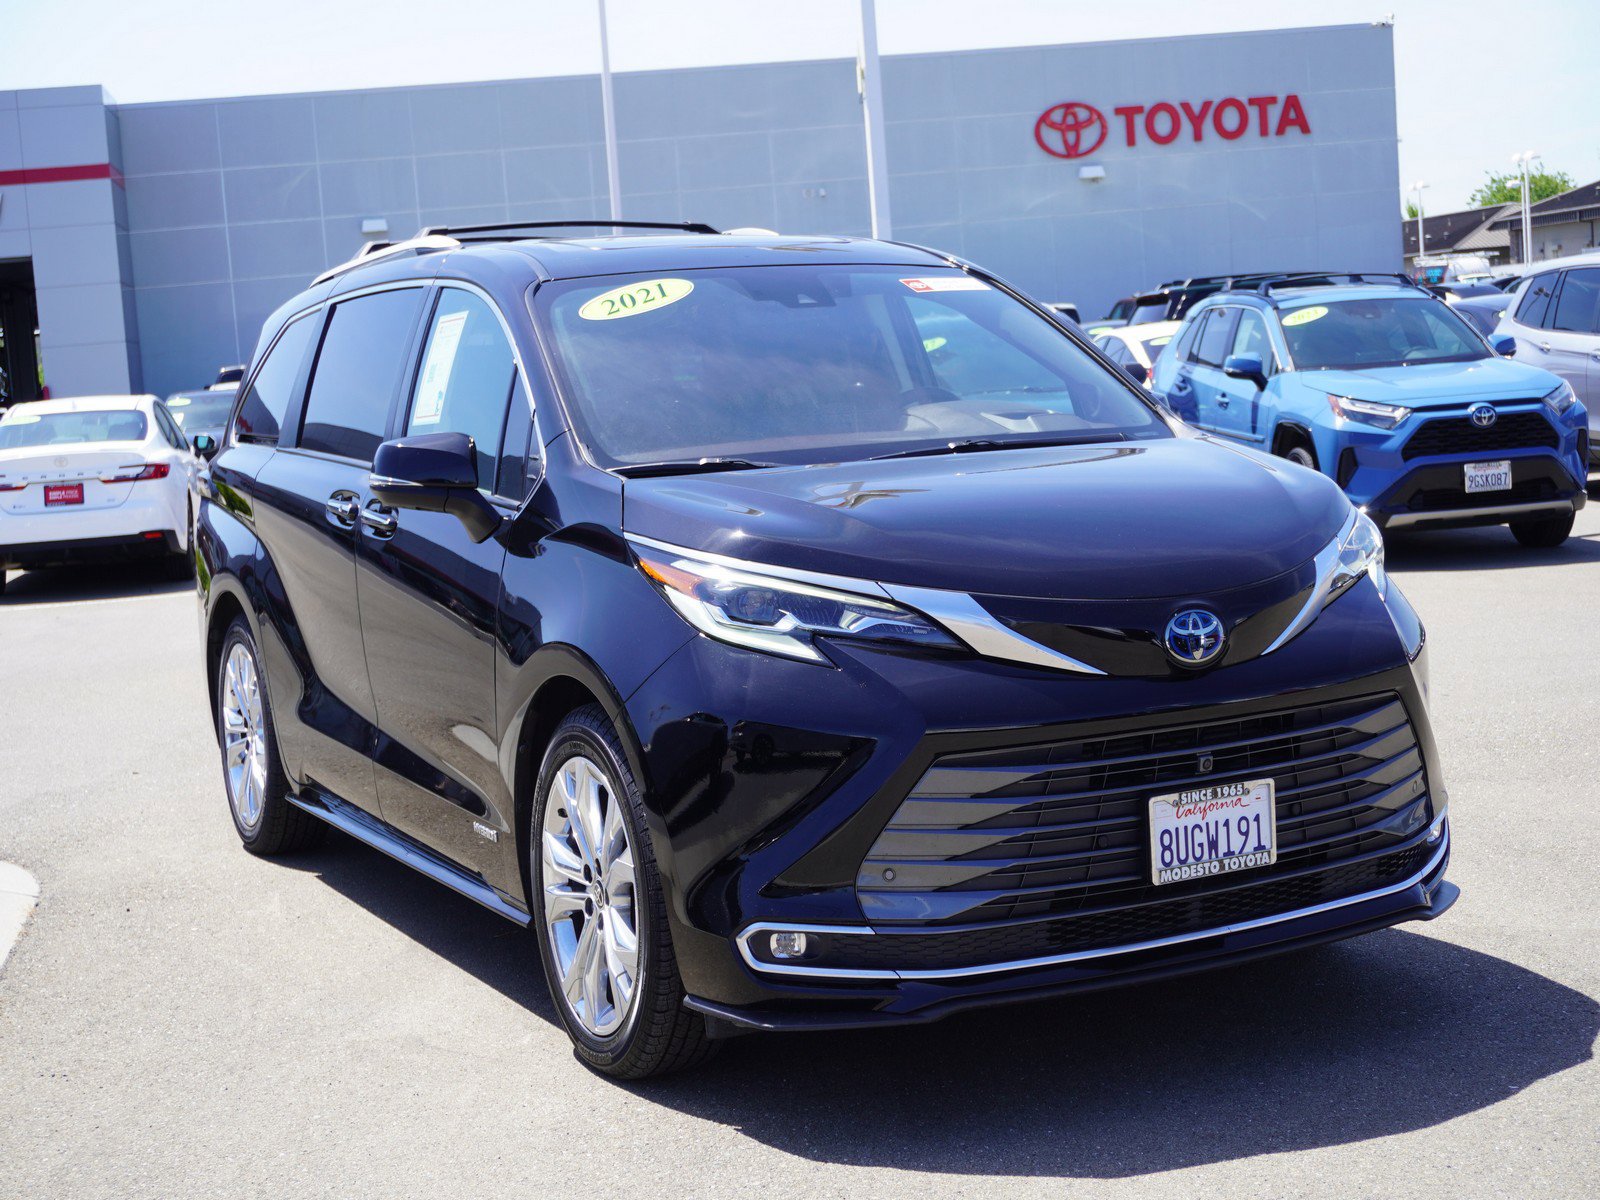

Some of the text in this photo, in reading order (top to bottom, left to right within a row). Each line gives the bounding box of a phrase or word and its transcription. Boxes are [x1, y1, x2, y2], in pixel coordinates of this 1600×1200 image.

[1114, 95, 1311, 147] TOYOTA
[601, 283, 667, 315] 2021
[1468, 472, 1508, 488] 9GSK087
[1175, 797, 1249, 821] California
[1180, 784, 1243, 805] SINCE 1965
[1159, 813, 1267, 868] 8UGW191
[1160, 852, 1271, 883] MODESTO TOYOTA
